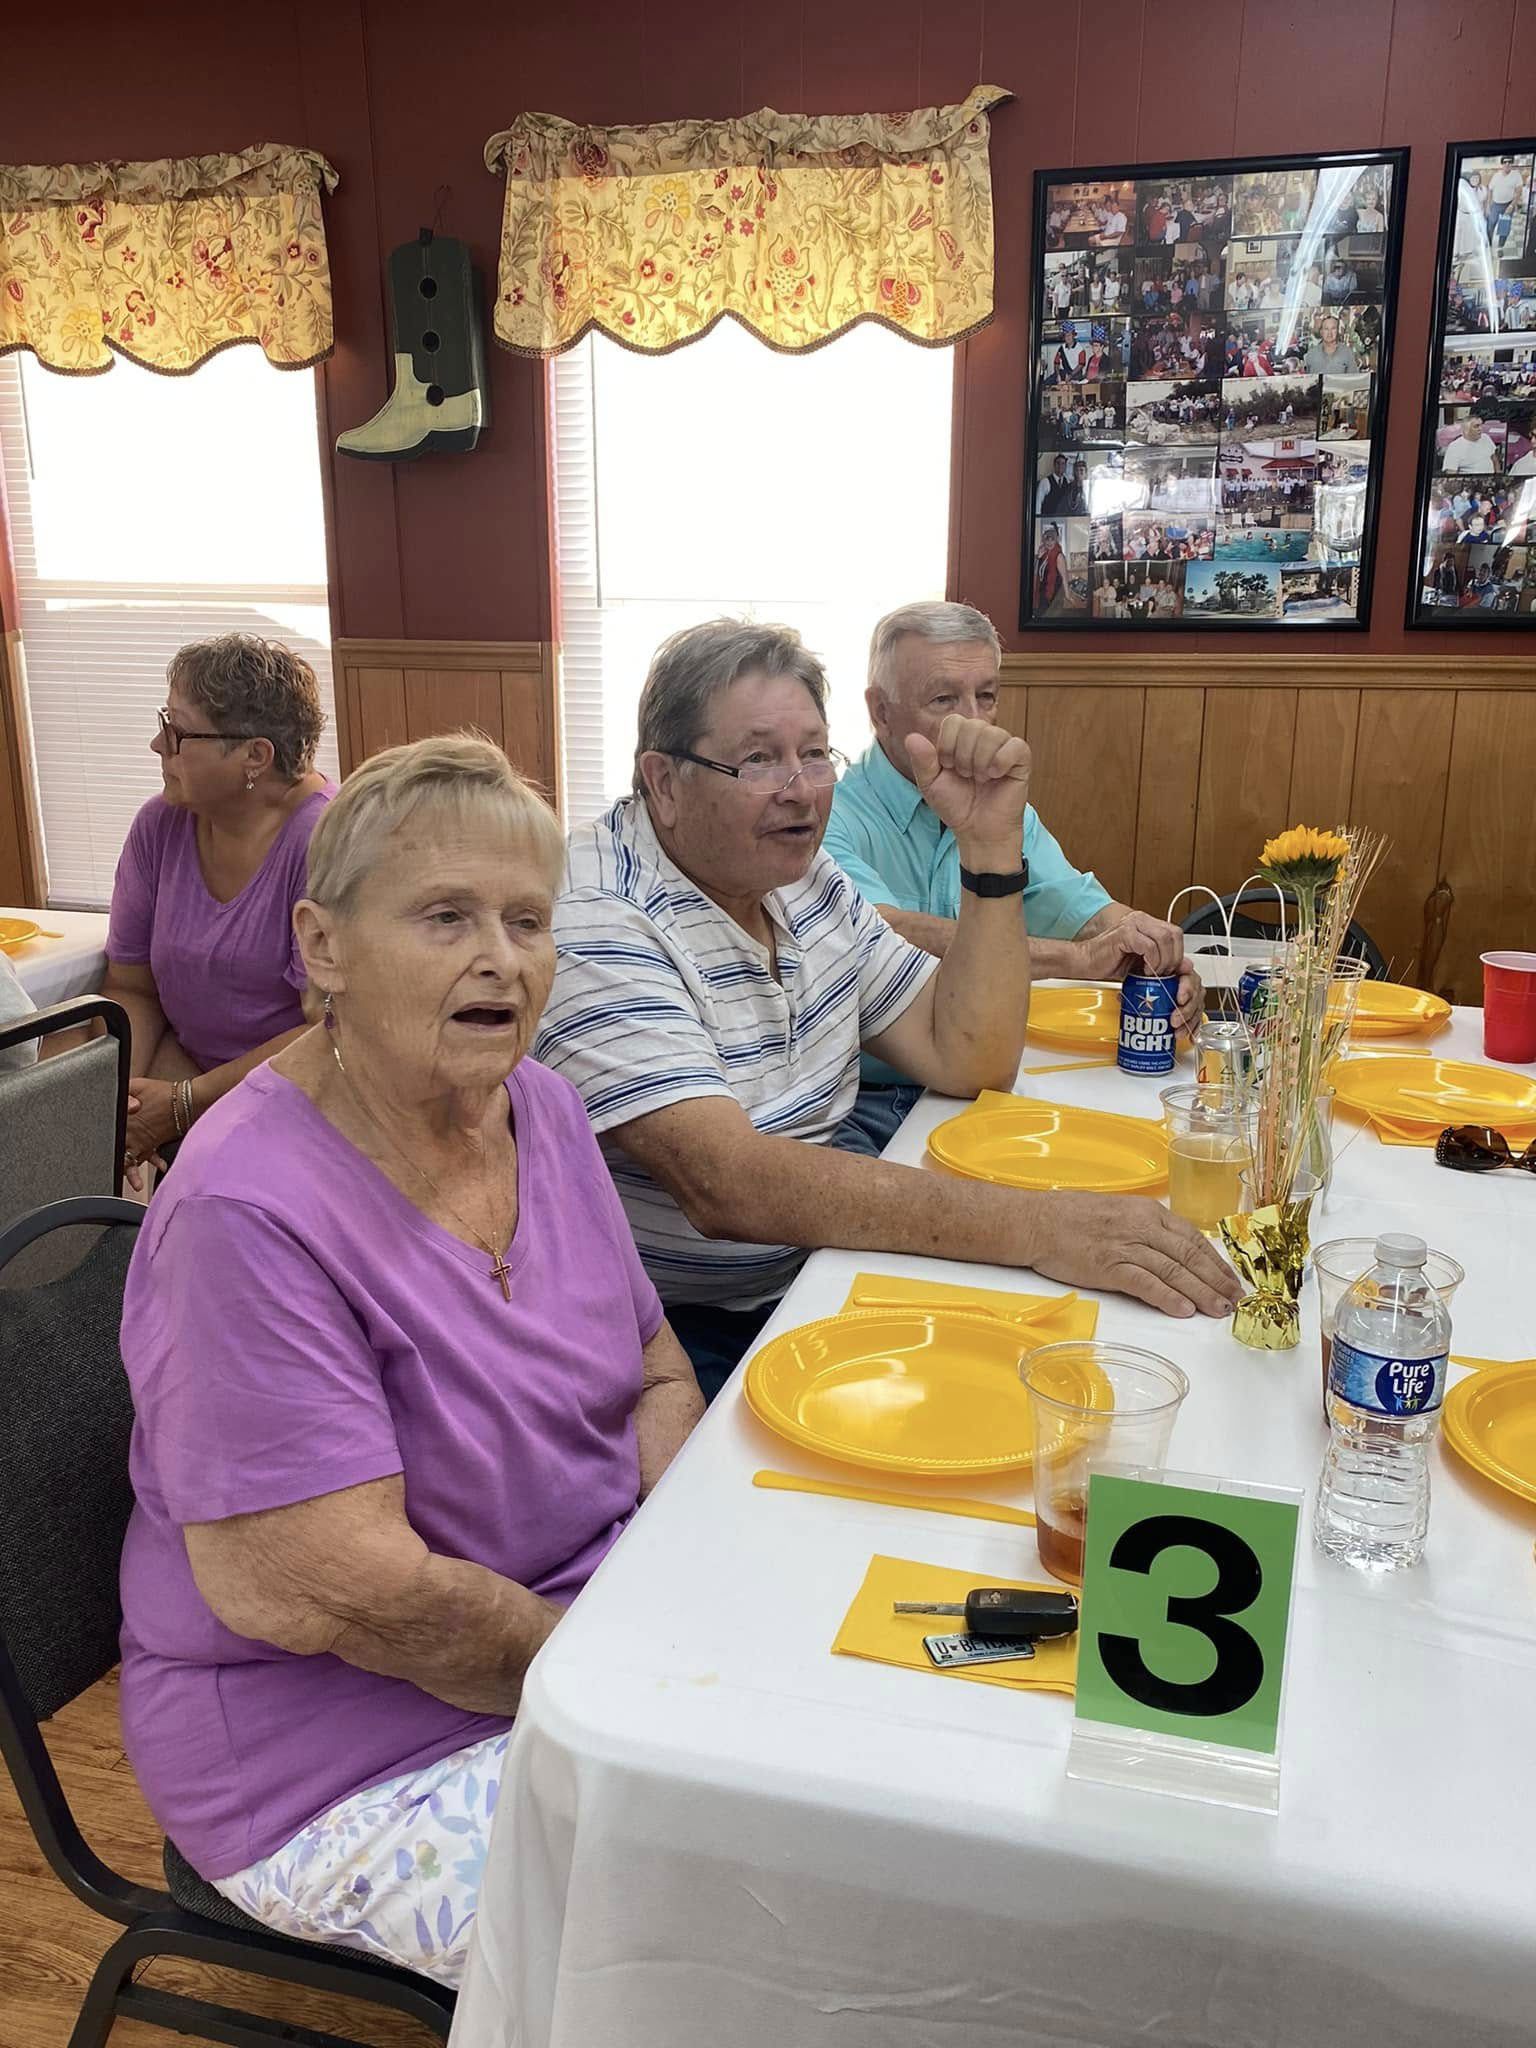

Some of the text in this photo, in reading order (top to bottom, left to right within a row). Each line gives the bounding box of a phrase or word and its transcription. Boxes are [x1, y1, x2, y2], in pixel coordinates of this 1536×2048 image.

[1123, 1014, 1168, 1035] BUD
[1119, 1029, 1173, 1051] LIGHT
[1389, 1361, 1430, 1378] Pure
[1392, 1378, 1424, 1398] Life
[1097, 1514, 1264, 1717] 3
